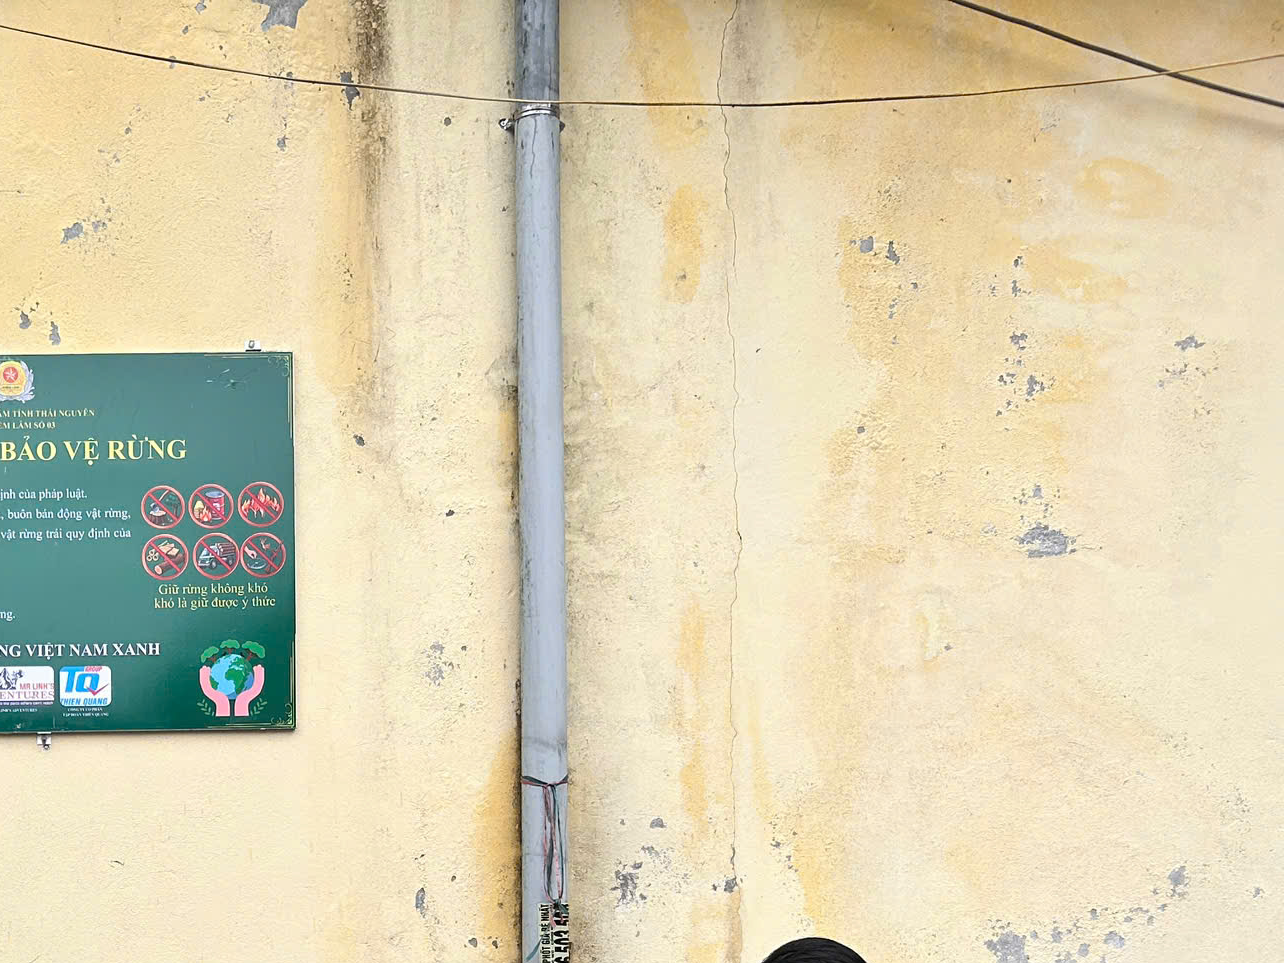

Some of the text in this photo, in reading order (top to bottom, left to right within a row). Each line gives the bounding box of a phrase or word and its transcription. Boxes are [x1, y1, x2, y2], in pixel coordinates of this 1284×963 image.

[36, 408, 57, 417] THÁI
[59, 408, 95, 417] NGUYÊN
[0, 435, 56, 461] BẢO
[63, 437, 99, 466] VỆ
[107, 434, 187, 460] RỪNG
[18, 489, 36, 499] của
[38, 488, 63, 501] pháp
[66, 488, 87, 500] luật.
[7, 509, 32, 519] buôn
[36, 508, 54, 519] bán
[57, 508, 82, 521] động
[86, 508, 101, 520] vật
[104, 508, 131, 520] rừng,
[1, 529, 16, 541] vật
[19, 529, 43, 541] rừng
[46, 528, 63, 539] trái
[65, 531, 85, 541] quy
[87, 528, 110, 539] định
[113, 528, 132, 538] của
[158, 582, 268, 597] Giữ rừng không khó
[154, 596, 276, 611] khó là giữ được ý thức
[25, 642, 65, 660] VIỆT
[69, 643, 108, 657] NAM
[112, 643, 161, 656] XANH
[32, 682, 55, 690] LINH'S
[83, 698, 108, 706] QUANG
